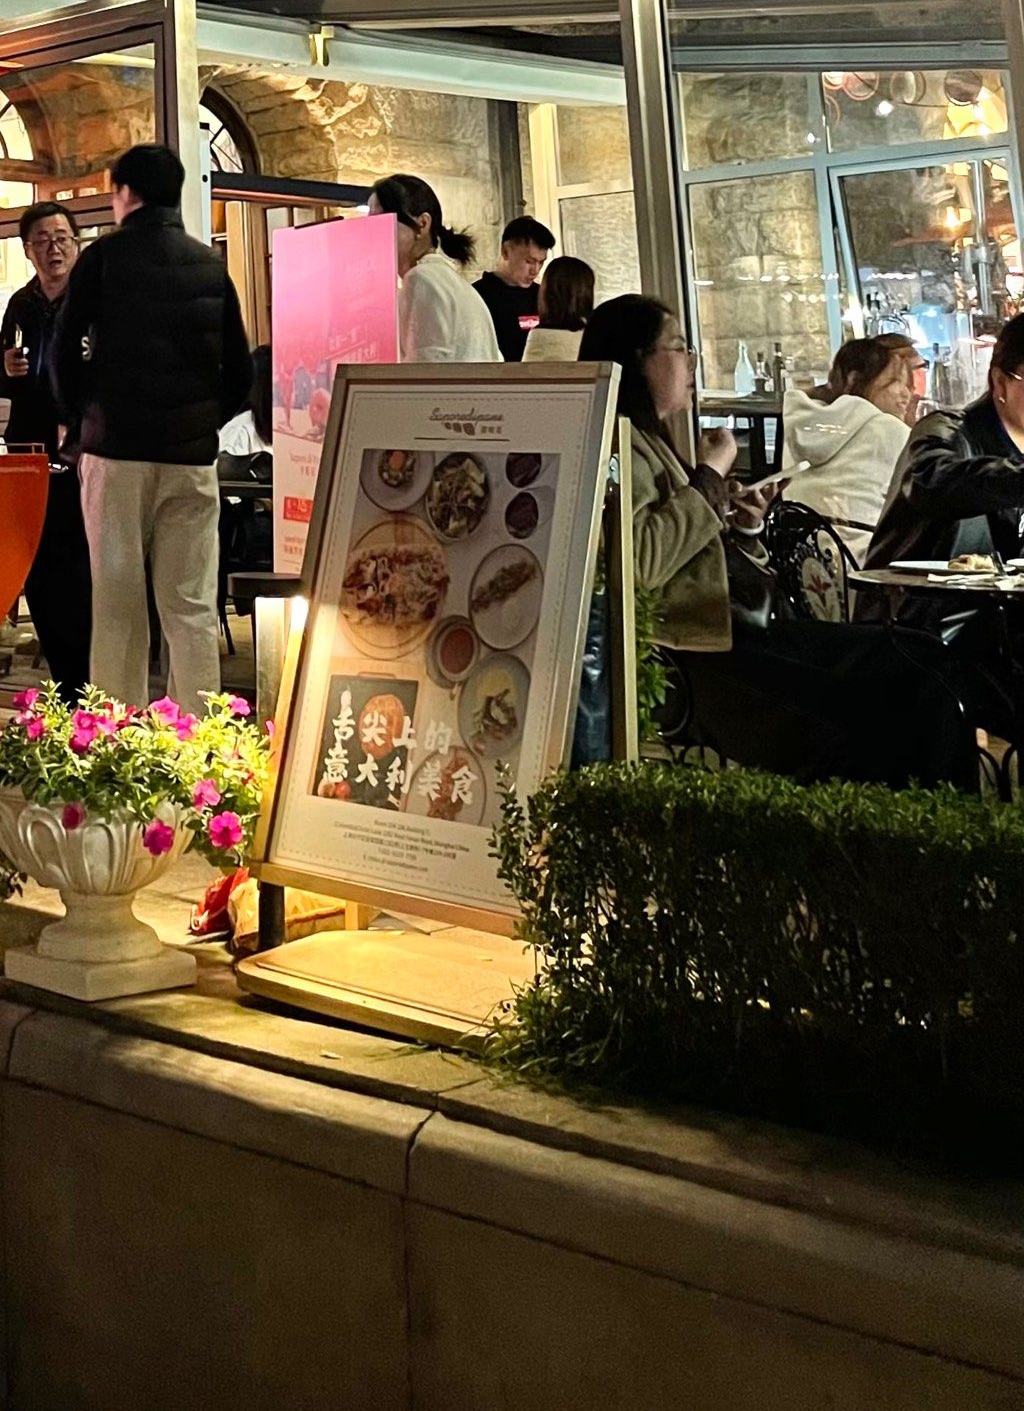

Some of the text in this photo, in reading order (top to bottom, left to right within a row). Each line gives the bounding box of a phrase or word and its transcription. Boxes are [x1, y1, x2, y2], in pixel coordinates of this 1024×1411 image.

[332, 689, 453, 755] 舌尖上的
[323, 740, 478, 805] 意大利美食
